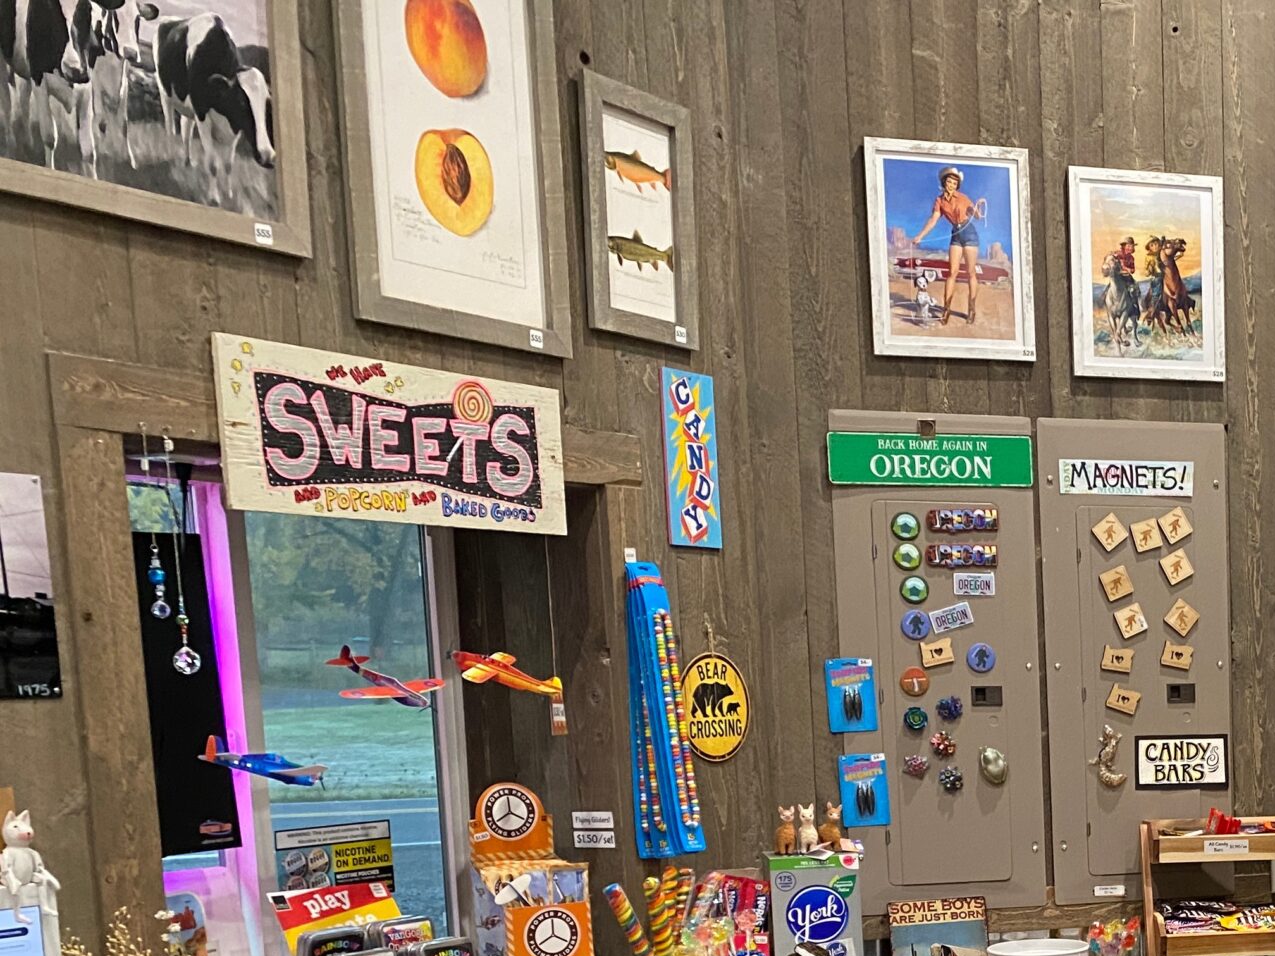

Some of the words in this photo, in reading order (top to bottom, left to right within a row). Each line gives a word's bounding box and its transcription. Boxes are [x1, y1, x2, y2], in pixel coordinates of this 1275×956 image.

[264, 382, 533, 497] SWEETS
[878, 439, 905, 450] BACK
[908, 439, 936, 451] HOME
[941, 439, 973, 451] AGAIN
[976, 440, 987, 451] IN
[674, 380, 714, 530] CANDY
[870, 453, 993, 480] OREGON
[1070, 462, 1185, 491] MAGNETS!
[325, 487, 407, 513] POPCORN
[442, 492, 487, 519] BAKED
[490, 502, 536, 522] GOODS
[958, 579, 991, 591] OREGON
[935, 609, 969, 627] OREGON
[696, 664, 727, 683] BEAR
[17, 684, 51, 696] 1975
[689, 717, 743, 740] CROSSING
[1146, 742, 1211, 761] CANDY
[1155, 764, 1204, 781] BARS
[335, 845, 376, 859] NICOTINE
[336, 858, 349, 868] ON
[352, 853, 389, 866] DEMAND
[303, 890, 351, 918] play
[890, 902, 937, 915] SOME
[942, 899, 984, 911] BOYS
[788, 895, 845, 943] York
[890, 914, 915, 925] ARE
[919, 912, 946, 922] JUST
[950, 910, 984, 920] BORN
